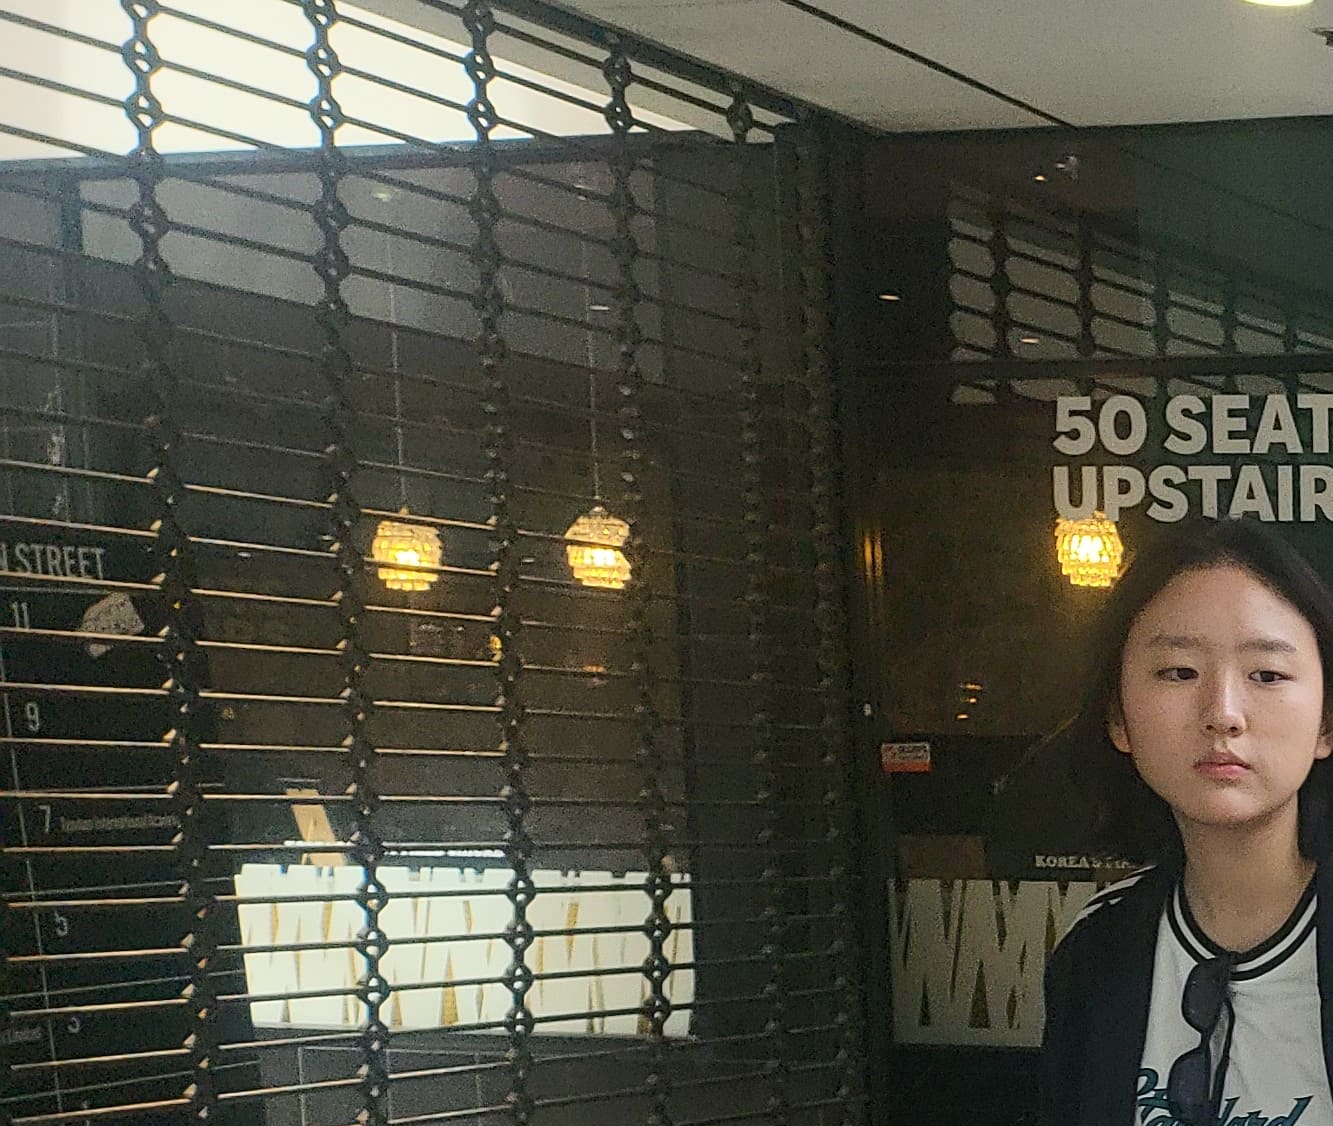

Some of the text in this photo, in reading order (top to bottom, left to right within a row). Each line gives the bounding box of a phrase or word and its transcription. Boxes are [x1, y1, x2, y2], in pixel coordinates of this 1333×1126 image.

[1053, 395, 1148, 456] 50
[15, 542, 104, 580] STREET
[26, 701, 40, 732] 9
